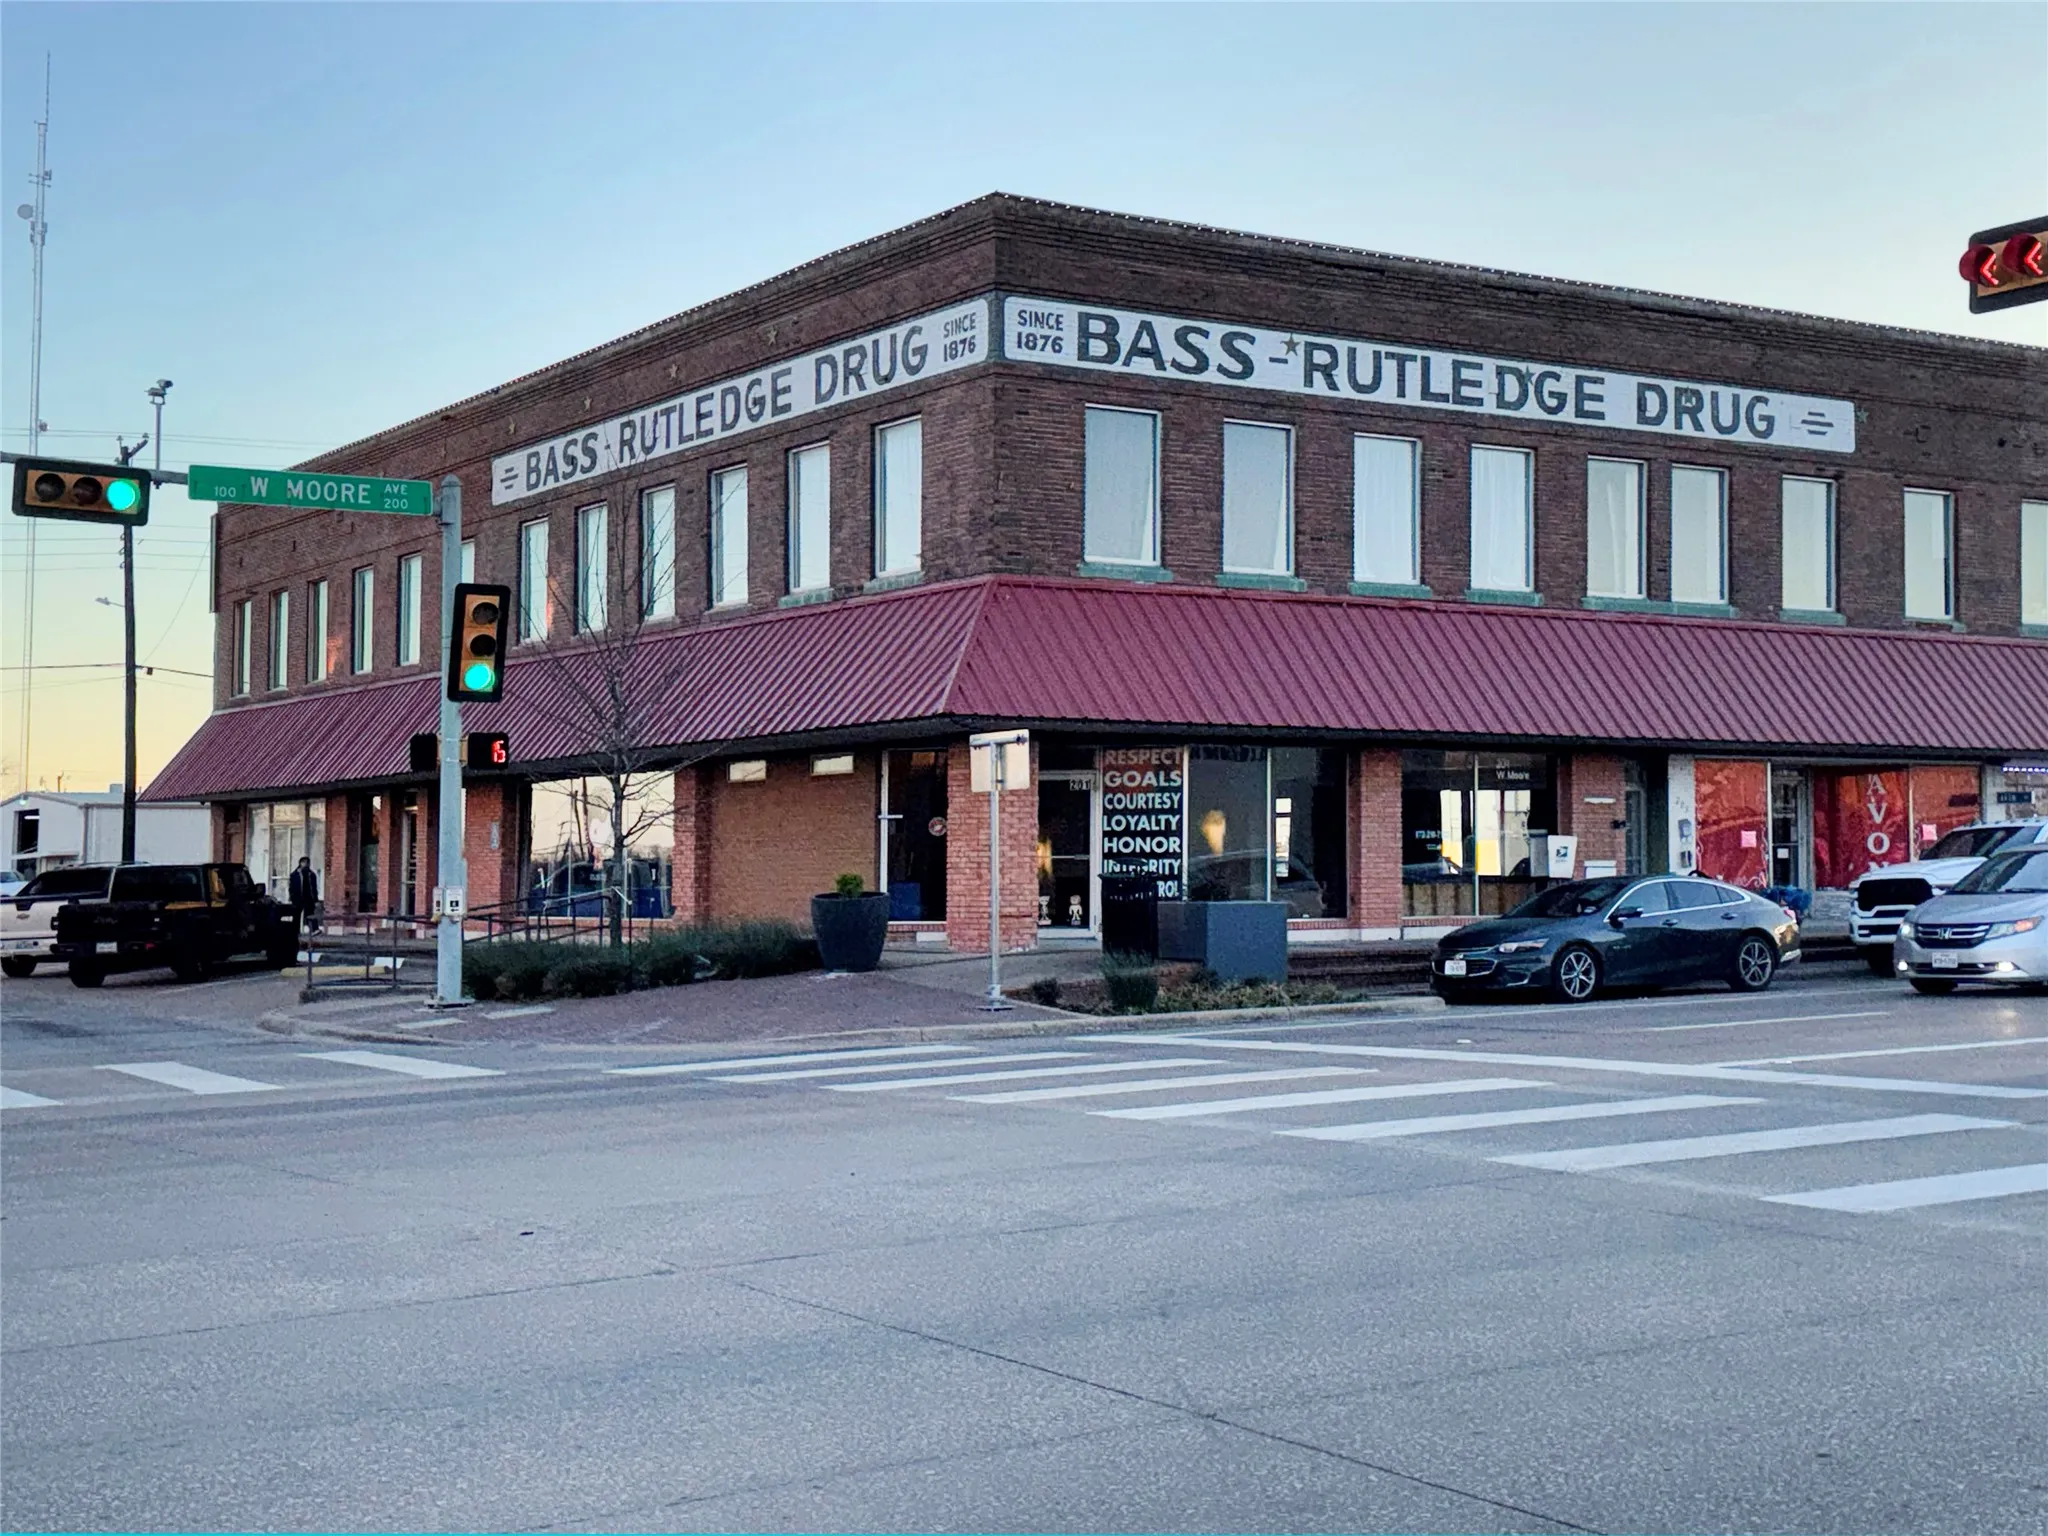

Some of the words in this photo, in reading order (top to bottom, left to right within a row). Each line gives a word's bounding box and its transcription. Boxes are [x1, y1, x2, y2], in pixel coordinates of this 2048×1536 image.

[943, 312, 977, 338] SINCE
[1017, 309, 1064, 331] SINCE
[943, 335, 977, 362] 1876
[1016, 332, 1064, 354] 1876
[814, 325, 928, 405] DRUG
[1636, 382, 1775, 440] DRUG
[214, 486, 236, 498] 100
[251, 476, 269, 498] W
[287, 478, 371, 504] MOORE
[384, 483, 408, 495] AVE
[384, 499, 408, 510] 200
[1103, 749, 1182, 765] RESPECT
[1070, 779, 1090, 791] 201
[1103, 770, 1182, 787] GOALS
[1103, 793, 1181, 809] COURTESY
[1102, 814, 1180, 831] LOYALTY
[1103, 836, 1181, 853] HONOR
